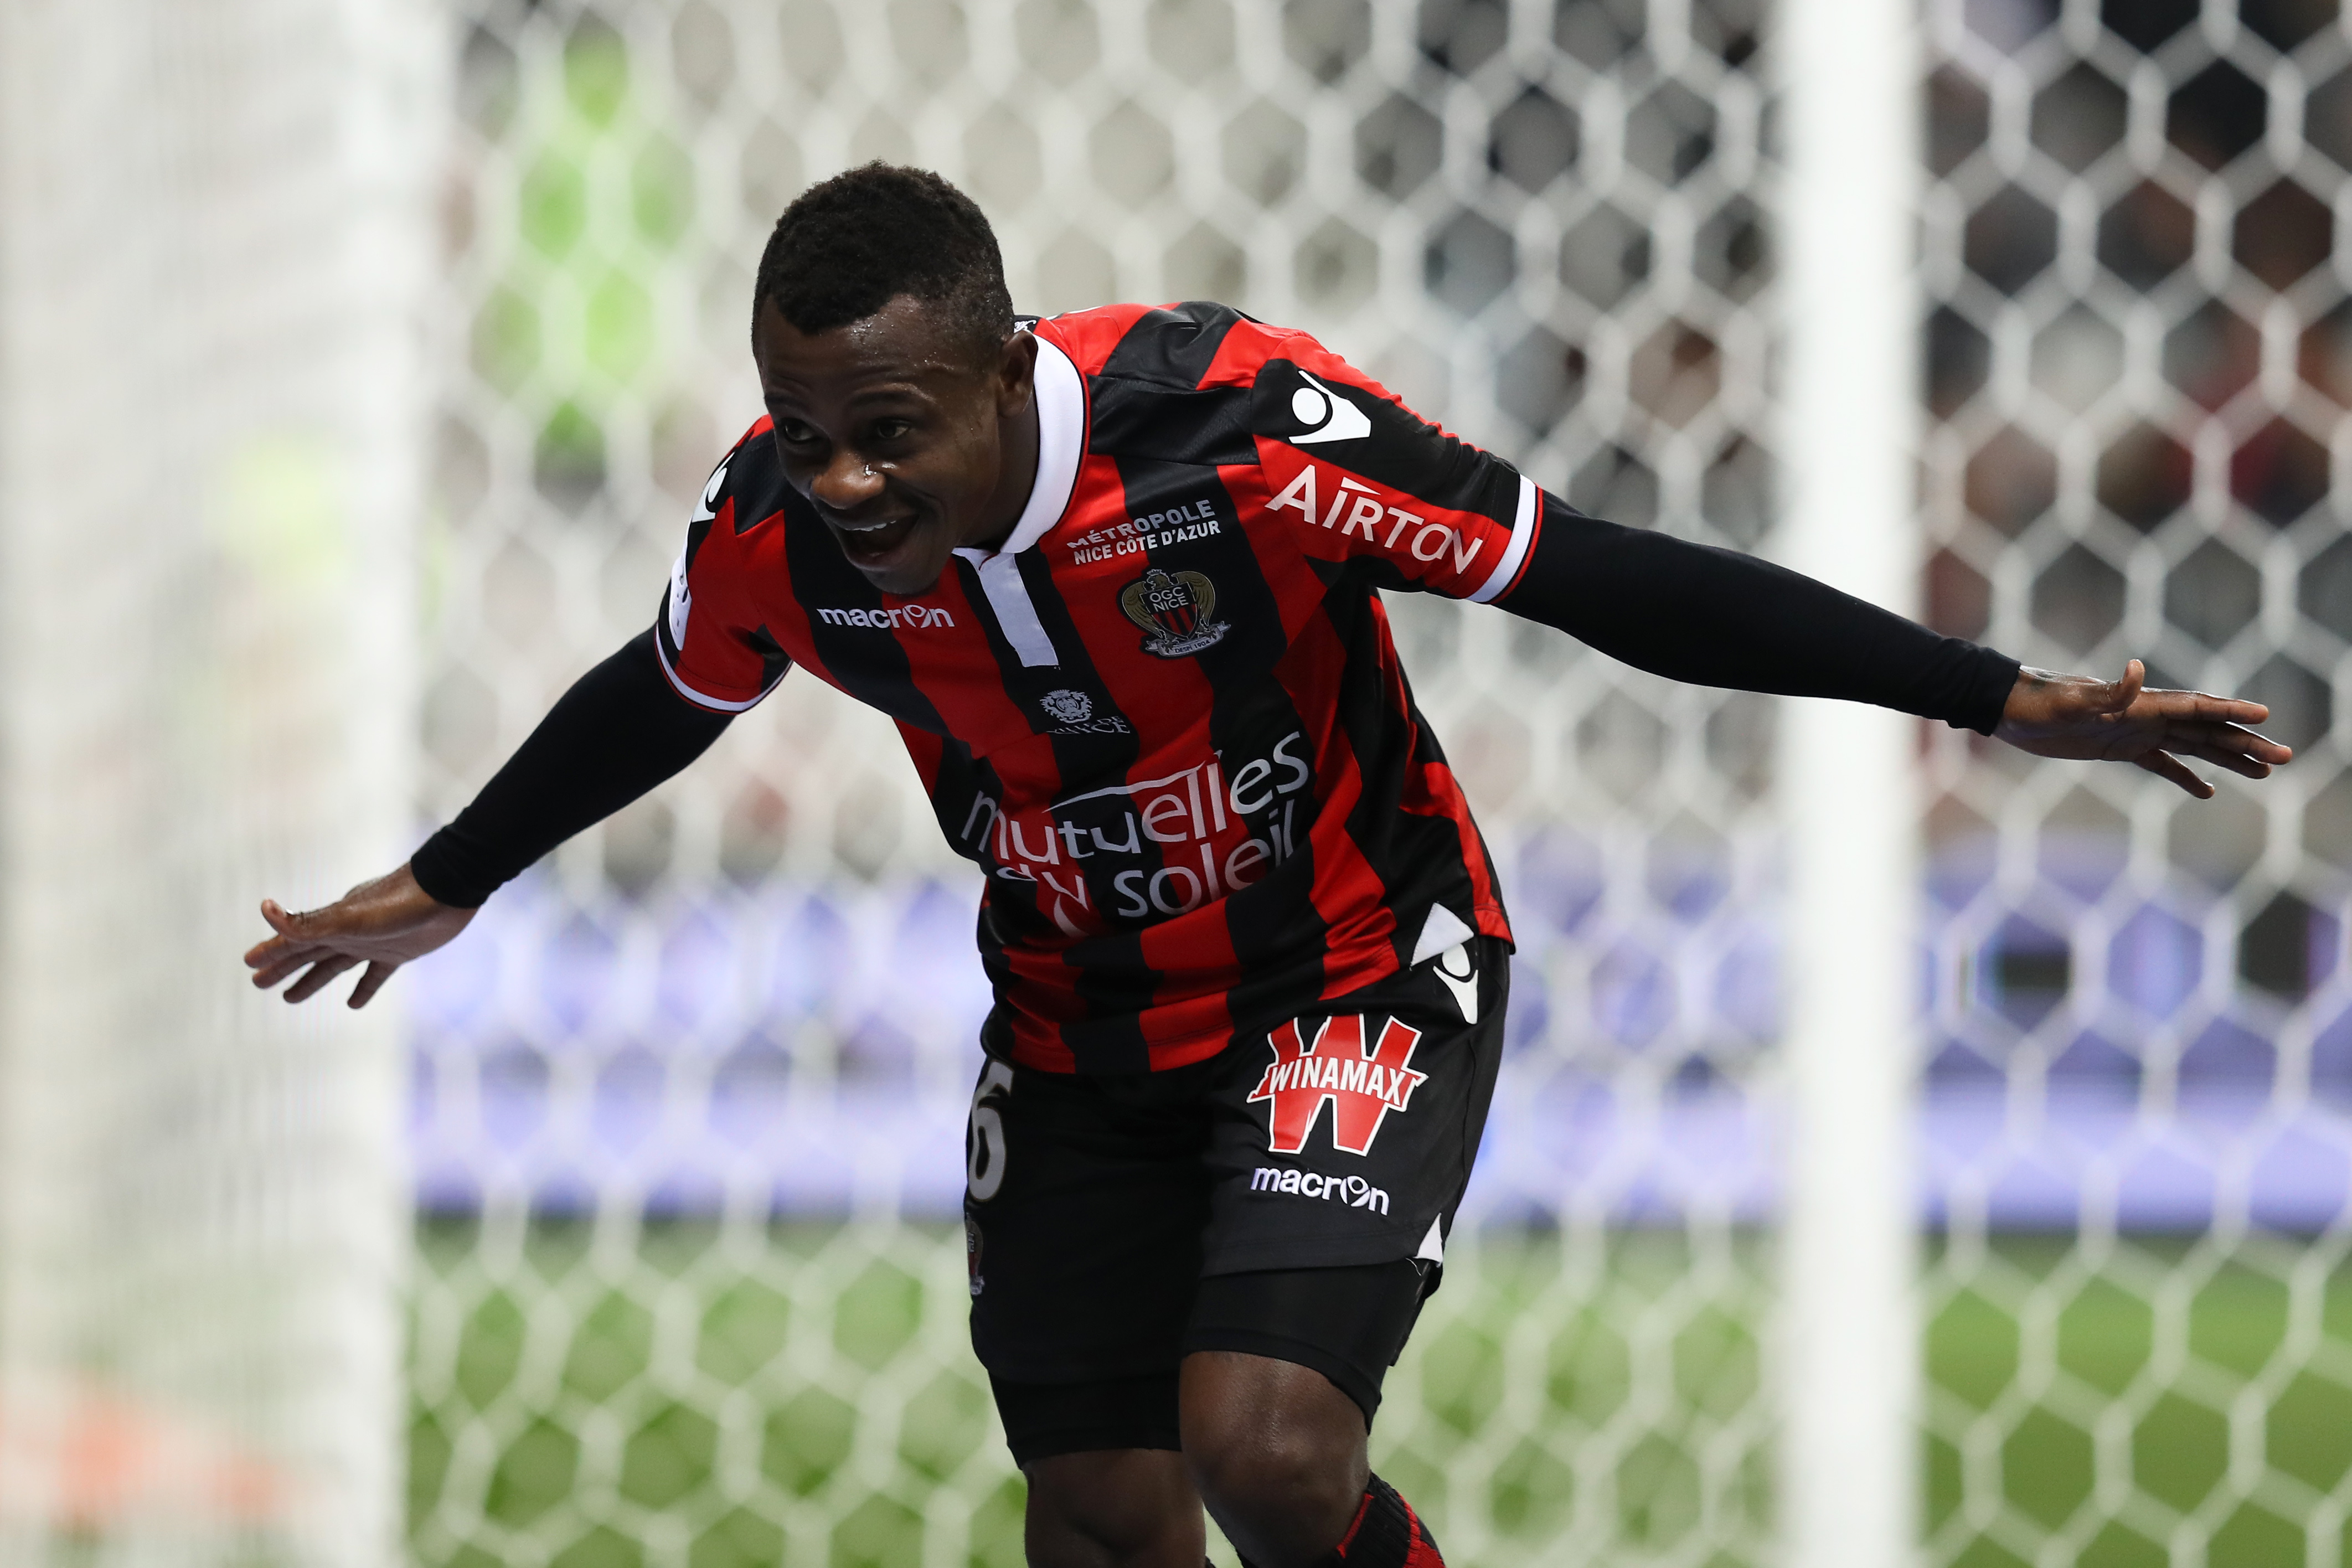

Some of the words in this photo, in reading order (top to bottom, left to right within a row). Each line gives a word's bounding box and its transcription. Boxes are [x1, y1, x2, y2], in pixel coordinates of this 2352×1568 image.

[1066, 499, 1216, 549] MÉTROPOLE
[1073, 544, 1113, 565] NICE
[1116, 534, 1158, 555] CÔTE
[1162, 520, 1221, 546] D'AZUR
[816, 604, 955, 628] macron
[1149, 586, 1184, 603] OGC
[1152, 596, 1189, 612] NICE
[1194, 639, 1211, 648] 1904
[961, 731, 1309, 866] mutuelles
[1113, 799, 1295, 918] soleil
[1268, 1056, 1406, 1106] WINAMAX
[967, 1060, 1015, 1203] 6
[1250, 1167, 1390, 1216] macron
